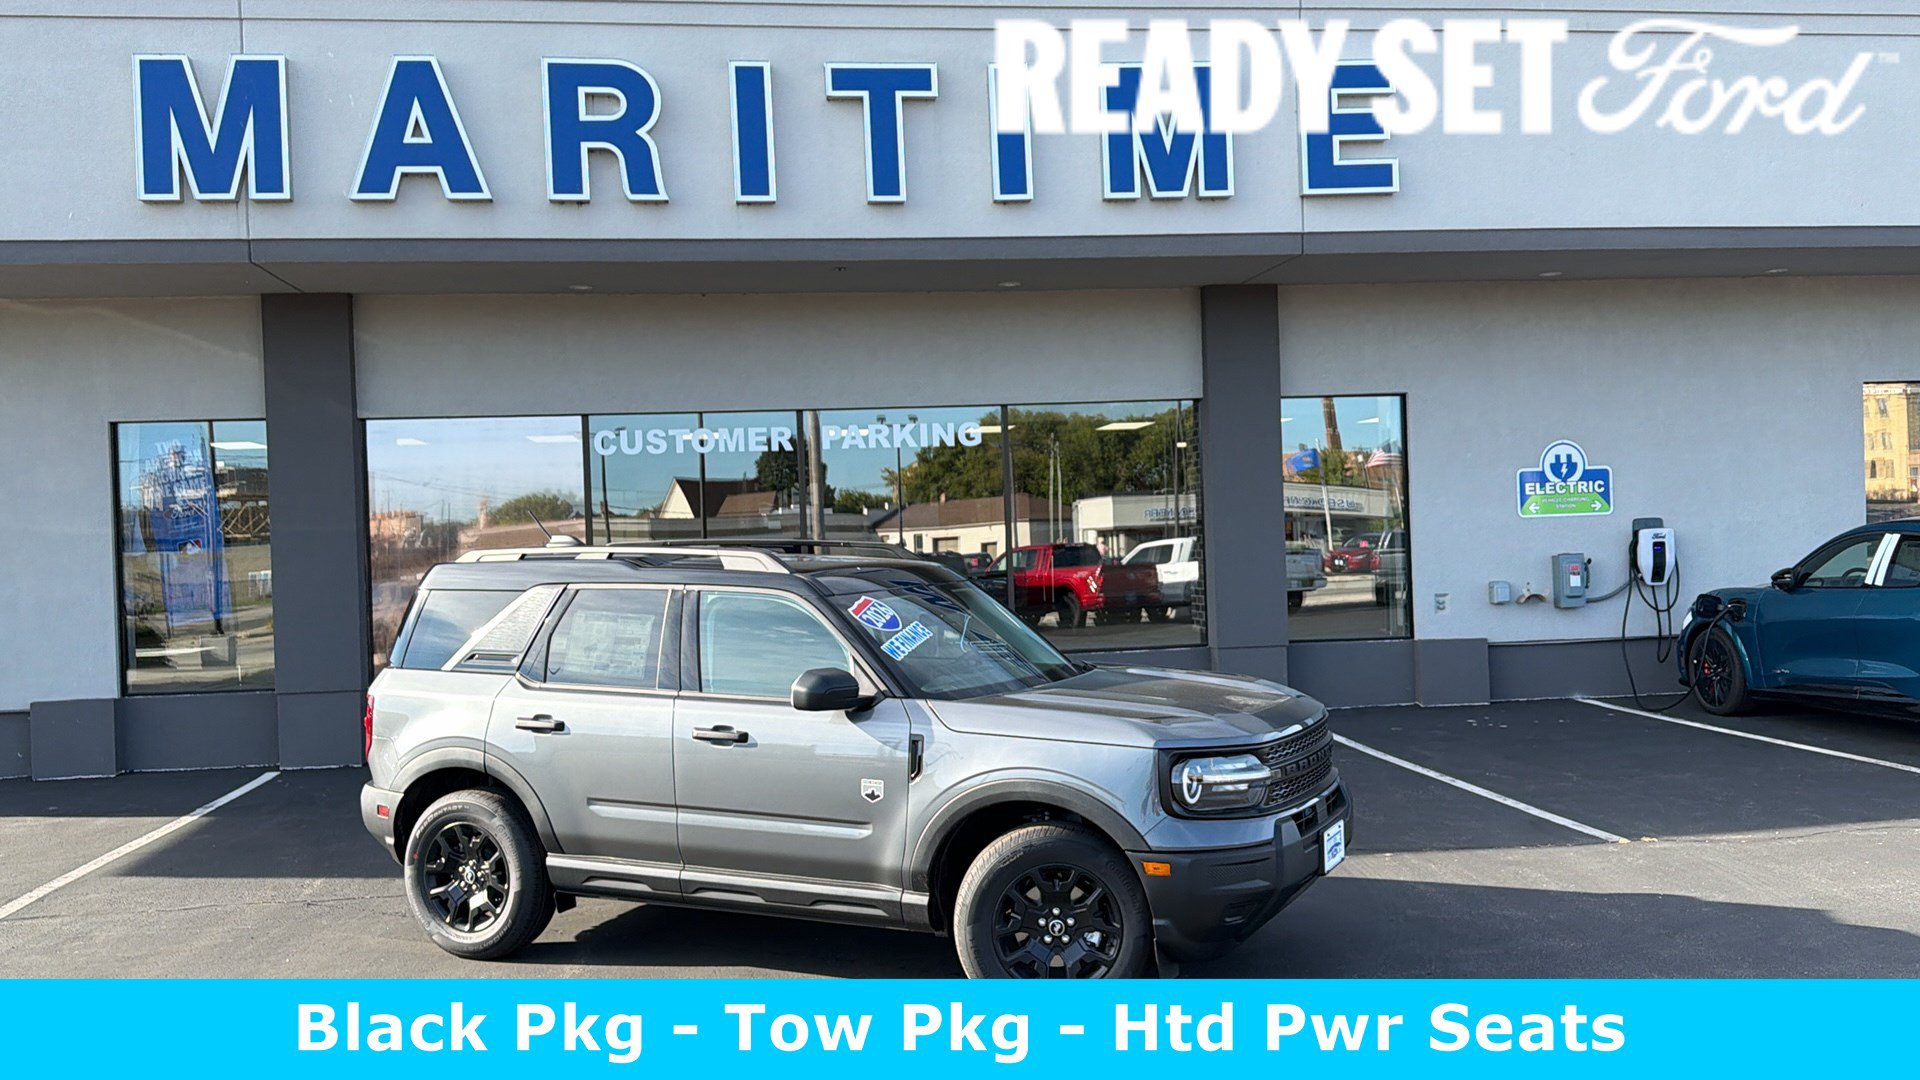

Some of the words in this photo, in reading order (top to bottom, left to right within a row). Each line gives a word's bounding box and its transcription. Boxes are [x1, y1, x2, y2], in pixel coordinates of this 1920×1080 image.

[132, 54, 1400, 203] MARITIME
[593, 426, 794, 456] CUSTOMER
[821, 421, 983, 451] PARKING
[1525, 480, 1605, 495] ELECTRIC
[861, 602, 894, 629] 2026
[892, 621, 933, 653] FINANCE
